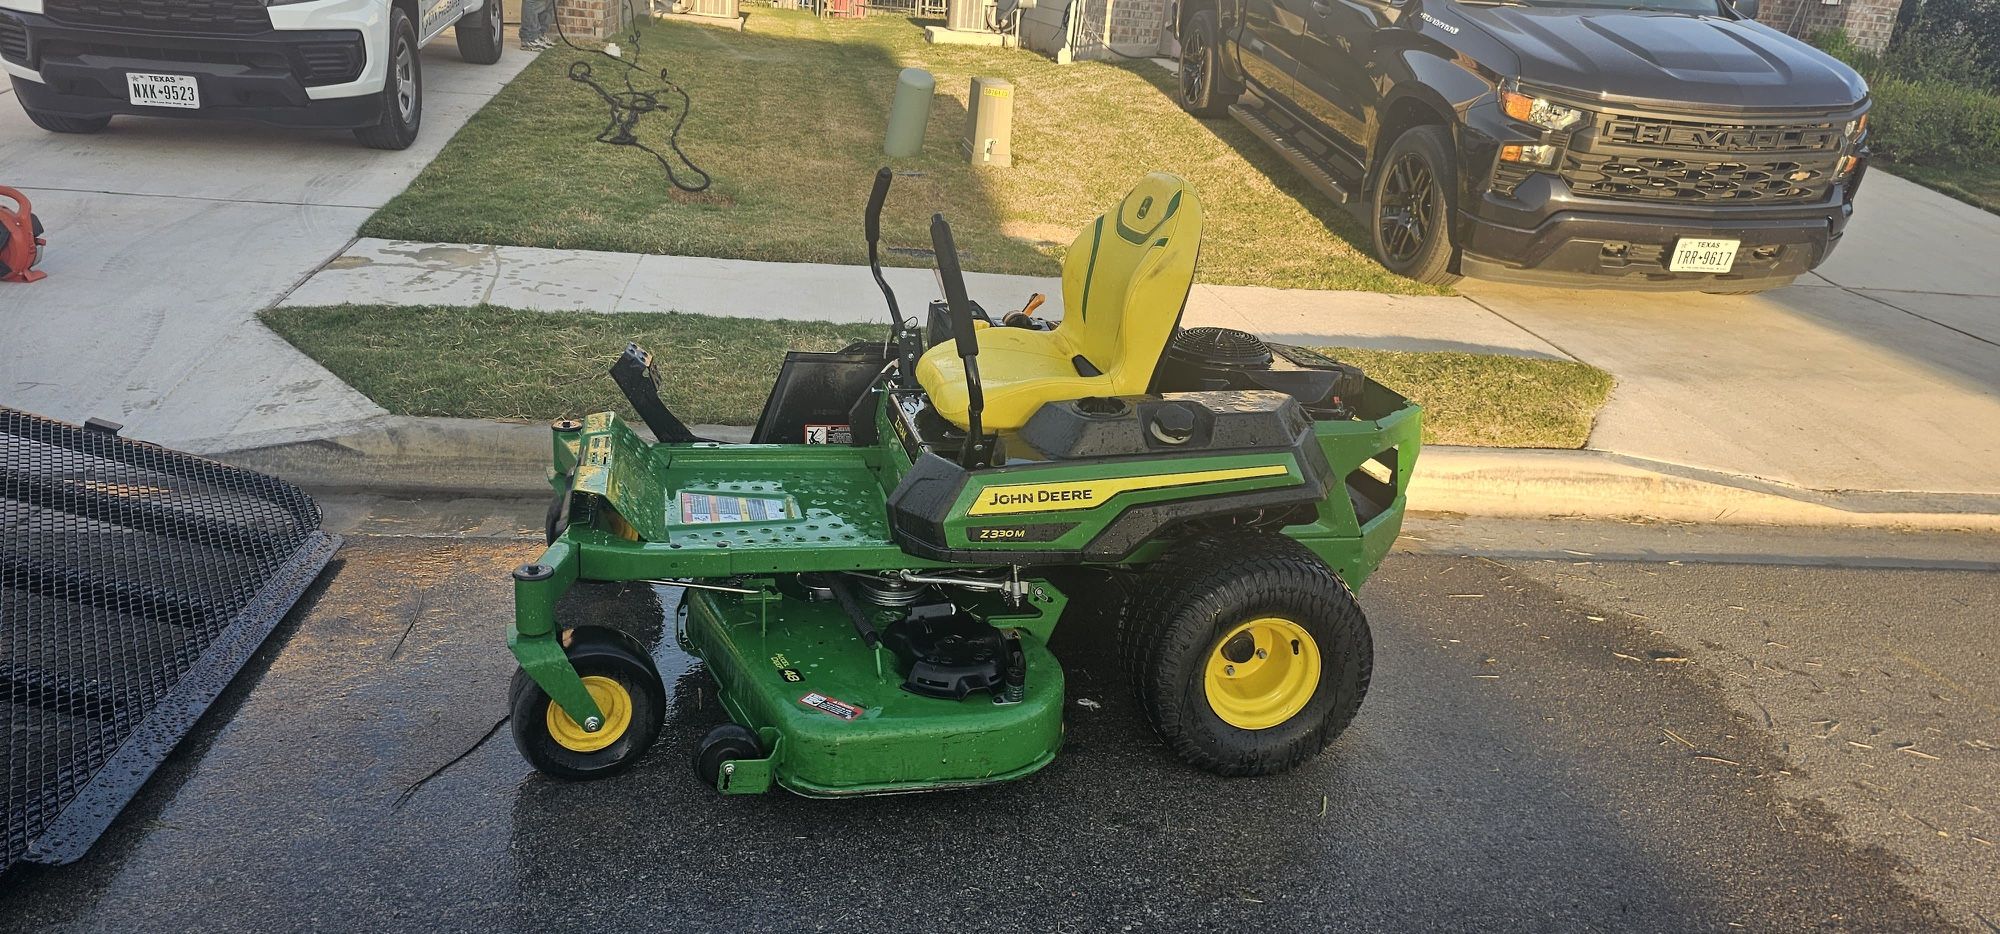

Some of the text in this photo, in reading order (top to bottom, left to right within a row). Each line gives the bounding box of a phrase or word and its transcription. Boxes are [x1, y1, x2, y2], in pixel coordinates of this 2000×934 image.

[148, 75, 176, 83] TEXAS
[1601, 117, 1844, 150] CHEVROLET
[989, 489, 1093, 505] JOHN DEERE
[979, 529, 1025, 539] Z330M
[784, 669, 800, 682] 48
